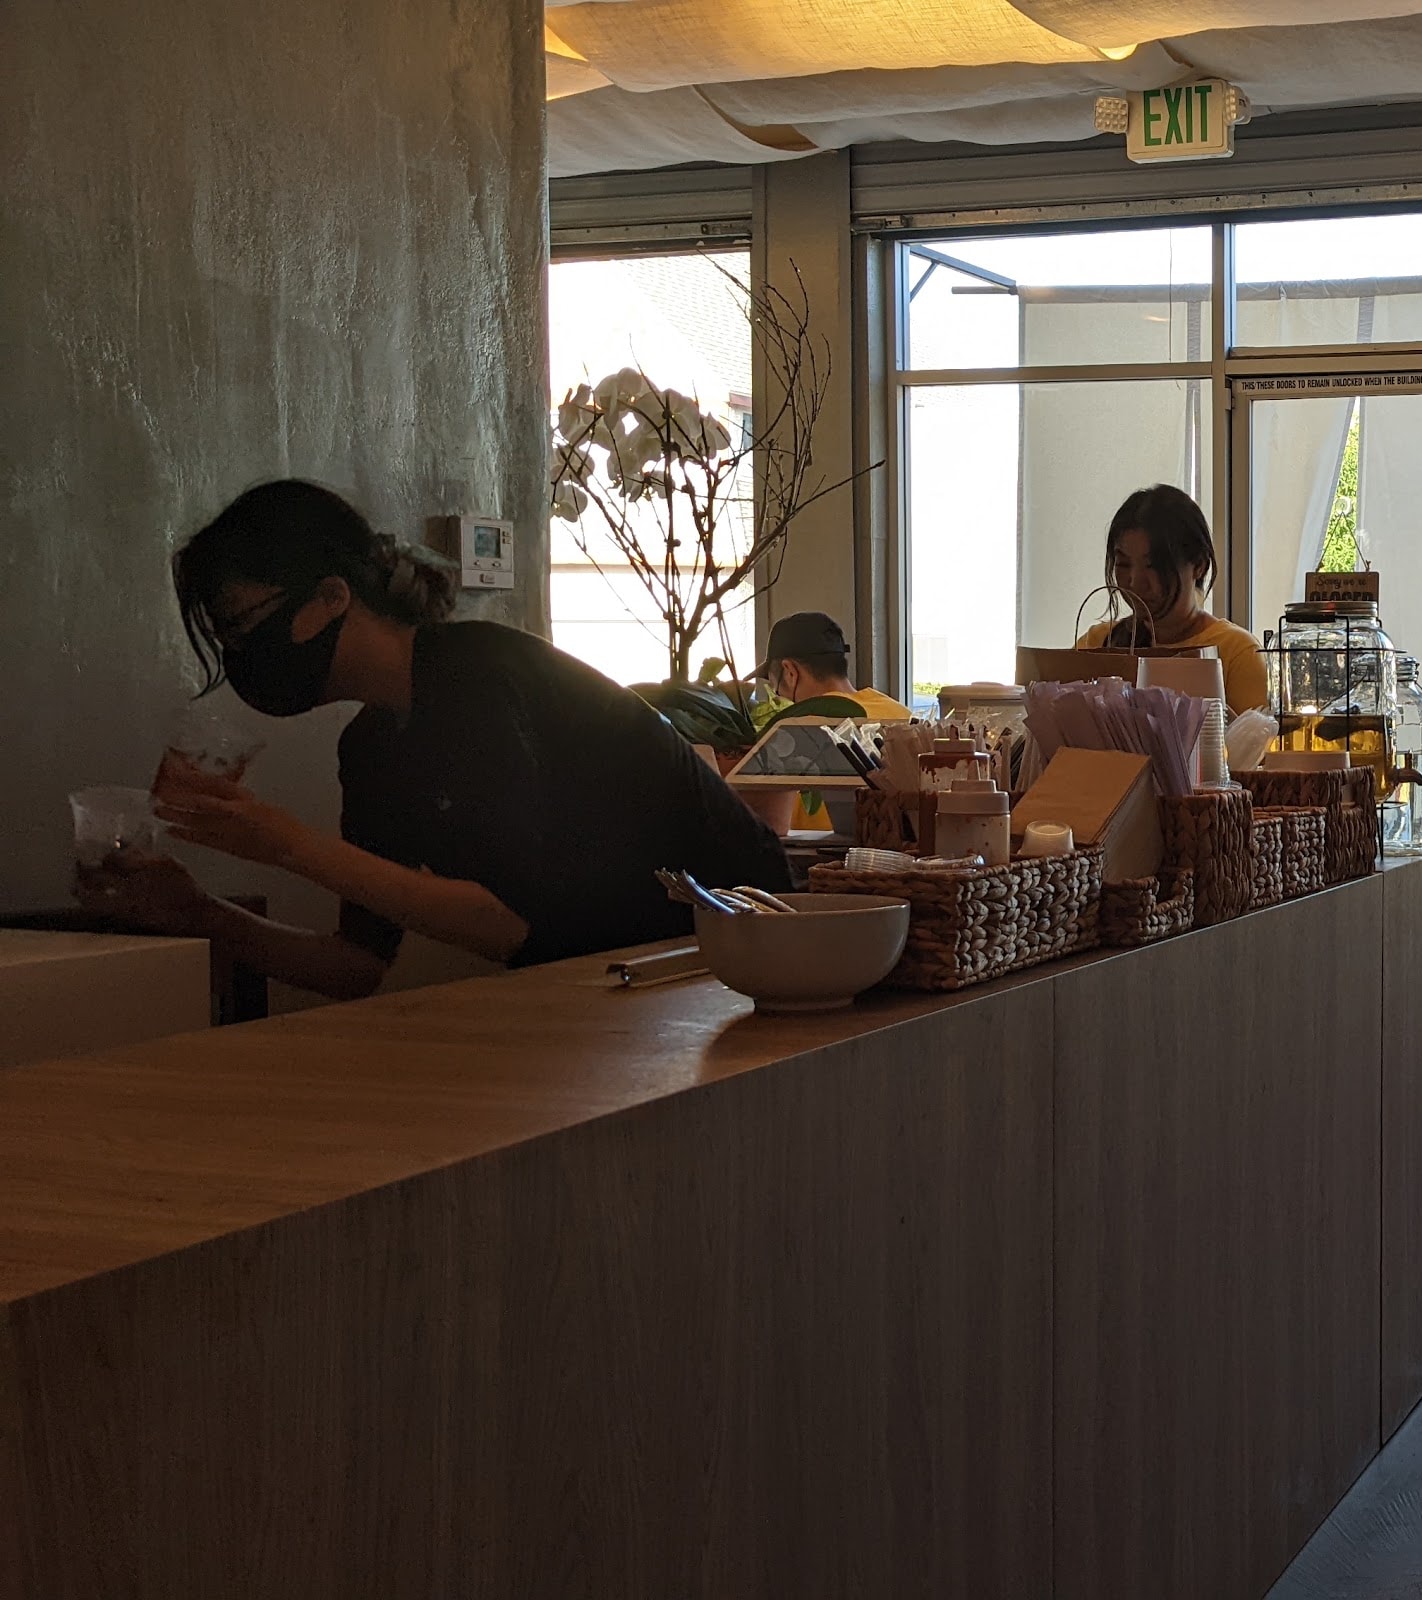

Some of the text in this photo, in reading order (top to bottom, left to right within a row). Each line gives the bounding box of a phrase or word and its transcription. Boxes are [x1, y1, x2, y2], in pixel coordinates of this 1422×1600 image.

[1143, 85, 1212, 146] EXIT
[1276, 380, 1296, 389] DOORS
[1298, 379, 1306, 388] TO
[1307, 378, 1330, 388] REMAIN
[1332, 377, 1362, 387] UNLOCKED
[1364, 377, 1382, 386] WHEN
[1384, 376, 1396, 385] THE
